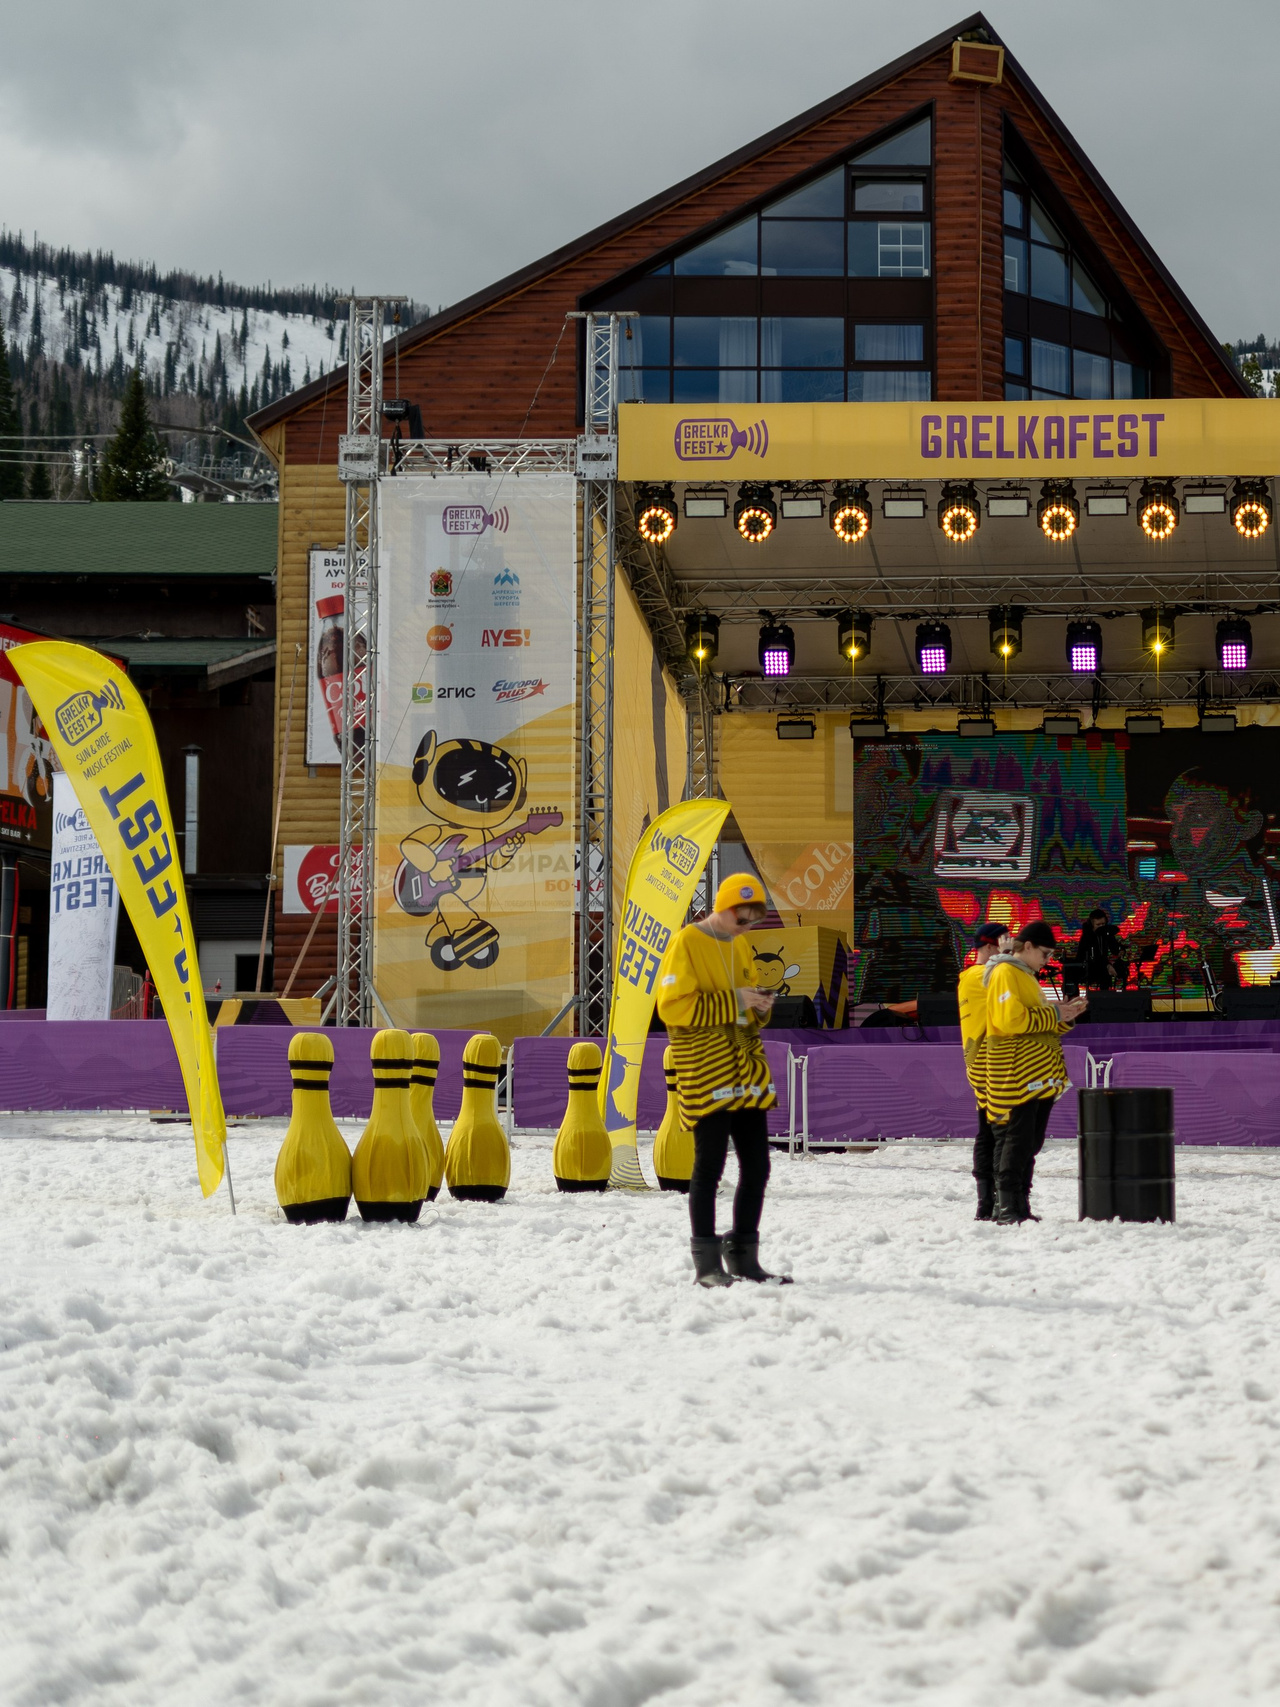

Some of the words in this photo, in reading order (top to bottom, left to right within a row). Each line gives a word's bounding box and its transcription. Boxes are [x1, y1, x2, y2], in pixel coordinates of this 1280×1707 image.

[684, 424, 728, 438] GRELKA
[921, 413, 1165, 459] GRELKAFEST
[684, 440, 714, 454] FEST
[449, 509, 481, 520] GRELKA
[449, 521, 470, 531] FEST
[481, 629, 531, 647] AYS!
[437, 687, 476, 699] 2ГИС
[60, 695, 90, 725] GRELKA
[67, 715, 89, 739] FEST
[76, 748, 91, 765] SUN
[90, 744, 97, 755] &
[95, 731, 112, 752] RIDE
[83, 757, 106, 781] MUSIC
[104, 737, 133, 765] FESTIVAL
[99, 771, 178, 919] FEST
